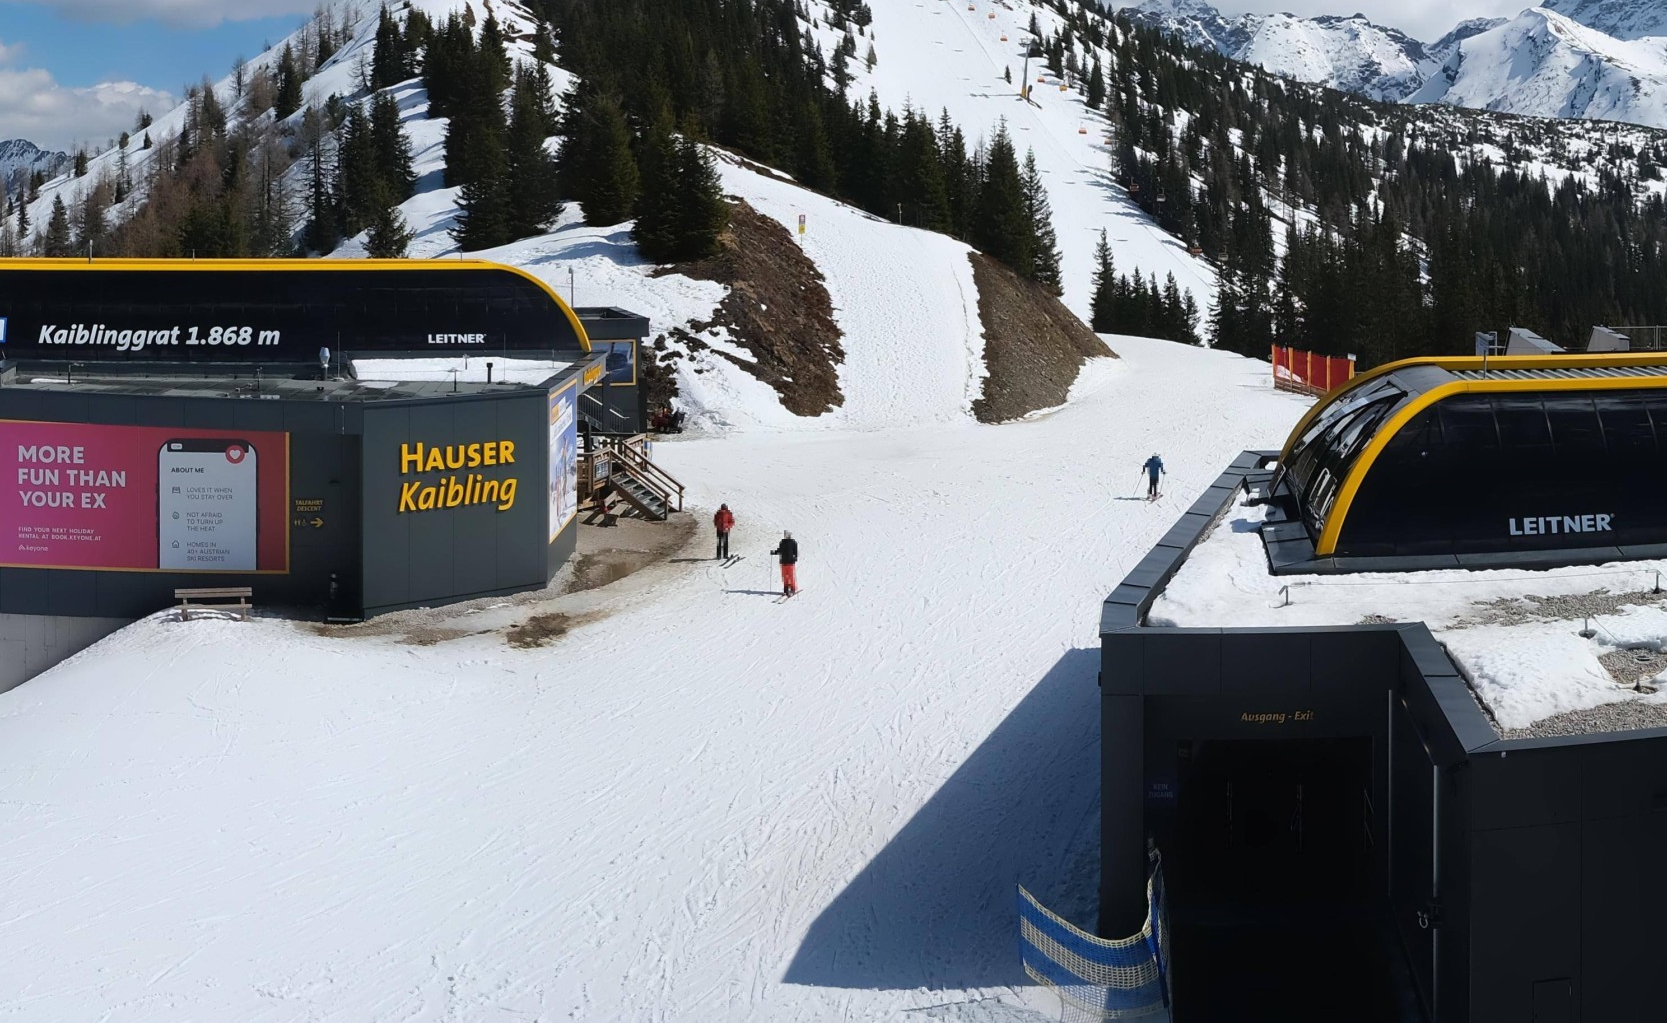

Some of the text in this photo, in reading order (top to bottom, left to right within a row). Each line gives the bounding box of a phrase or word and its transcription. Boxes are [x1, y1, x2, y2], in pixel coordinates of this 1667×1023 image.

[38, 324, 281, 351] Kaiblinggrat 1.868 m
[18, 445, 84, 464] MORE
[401, 440, 516, 474] HAUSER
[18, 468, 126, 487] FUN THAN
[19, 491, 106, 509] YOUR EX
[399, 474, 517, 512] Kaibling
[1241, 712, 1285, 724] Ausgang
[1294, 710, 1314, 720] Exit
